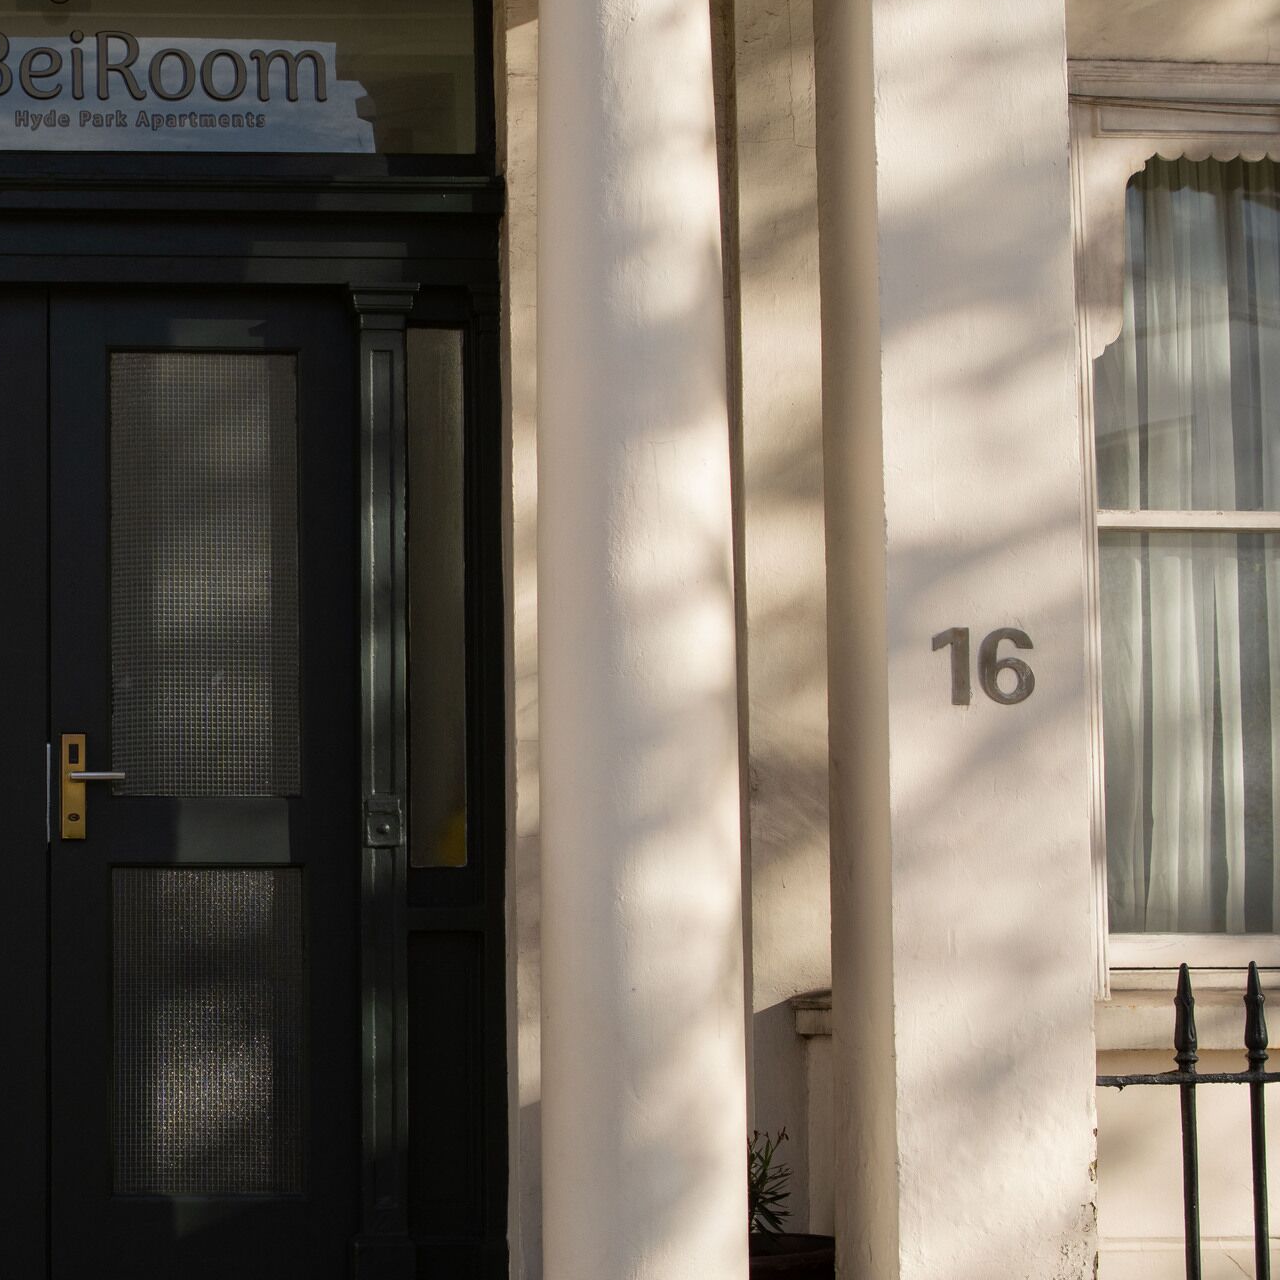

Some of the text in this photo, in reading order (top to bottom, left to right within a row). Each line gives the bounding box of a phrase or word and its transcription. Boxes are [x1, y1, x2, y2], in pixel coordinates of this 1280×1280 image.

[15, 109, 266, 131] Hyde Park Apartments
[931, 627, 1035, 706] 16
